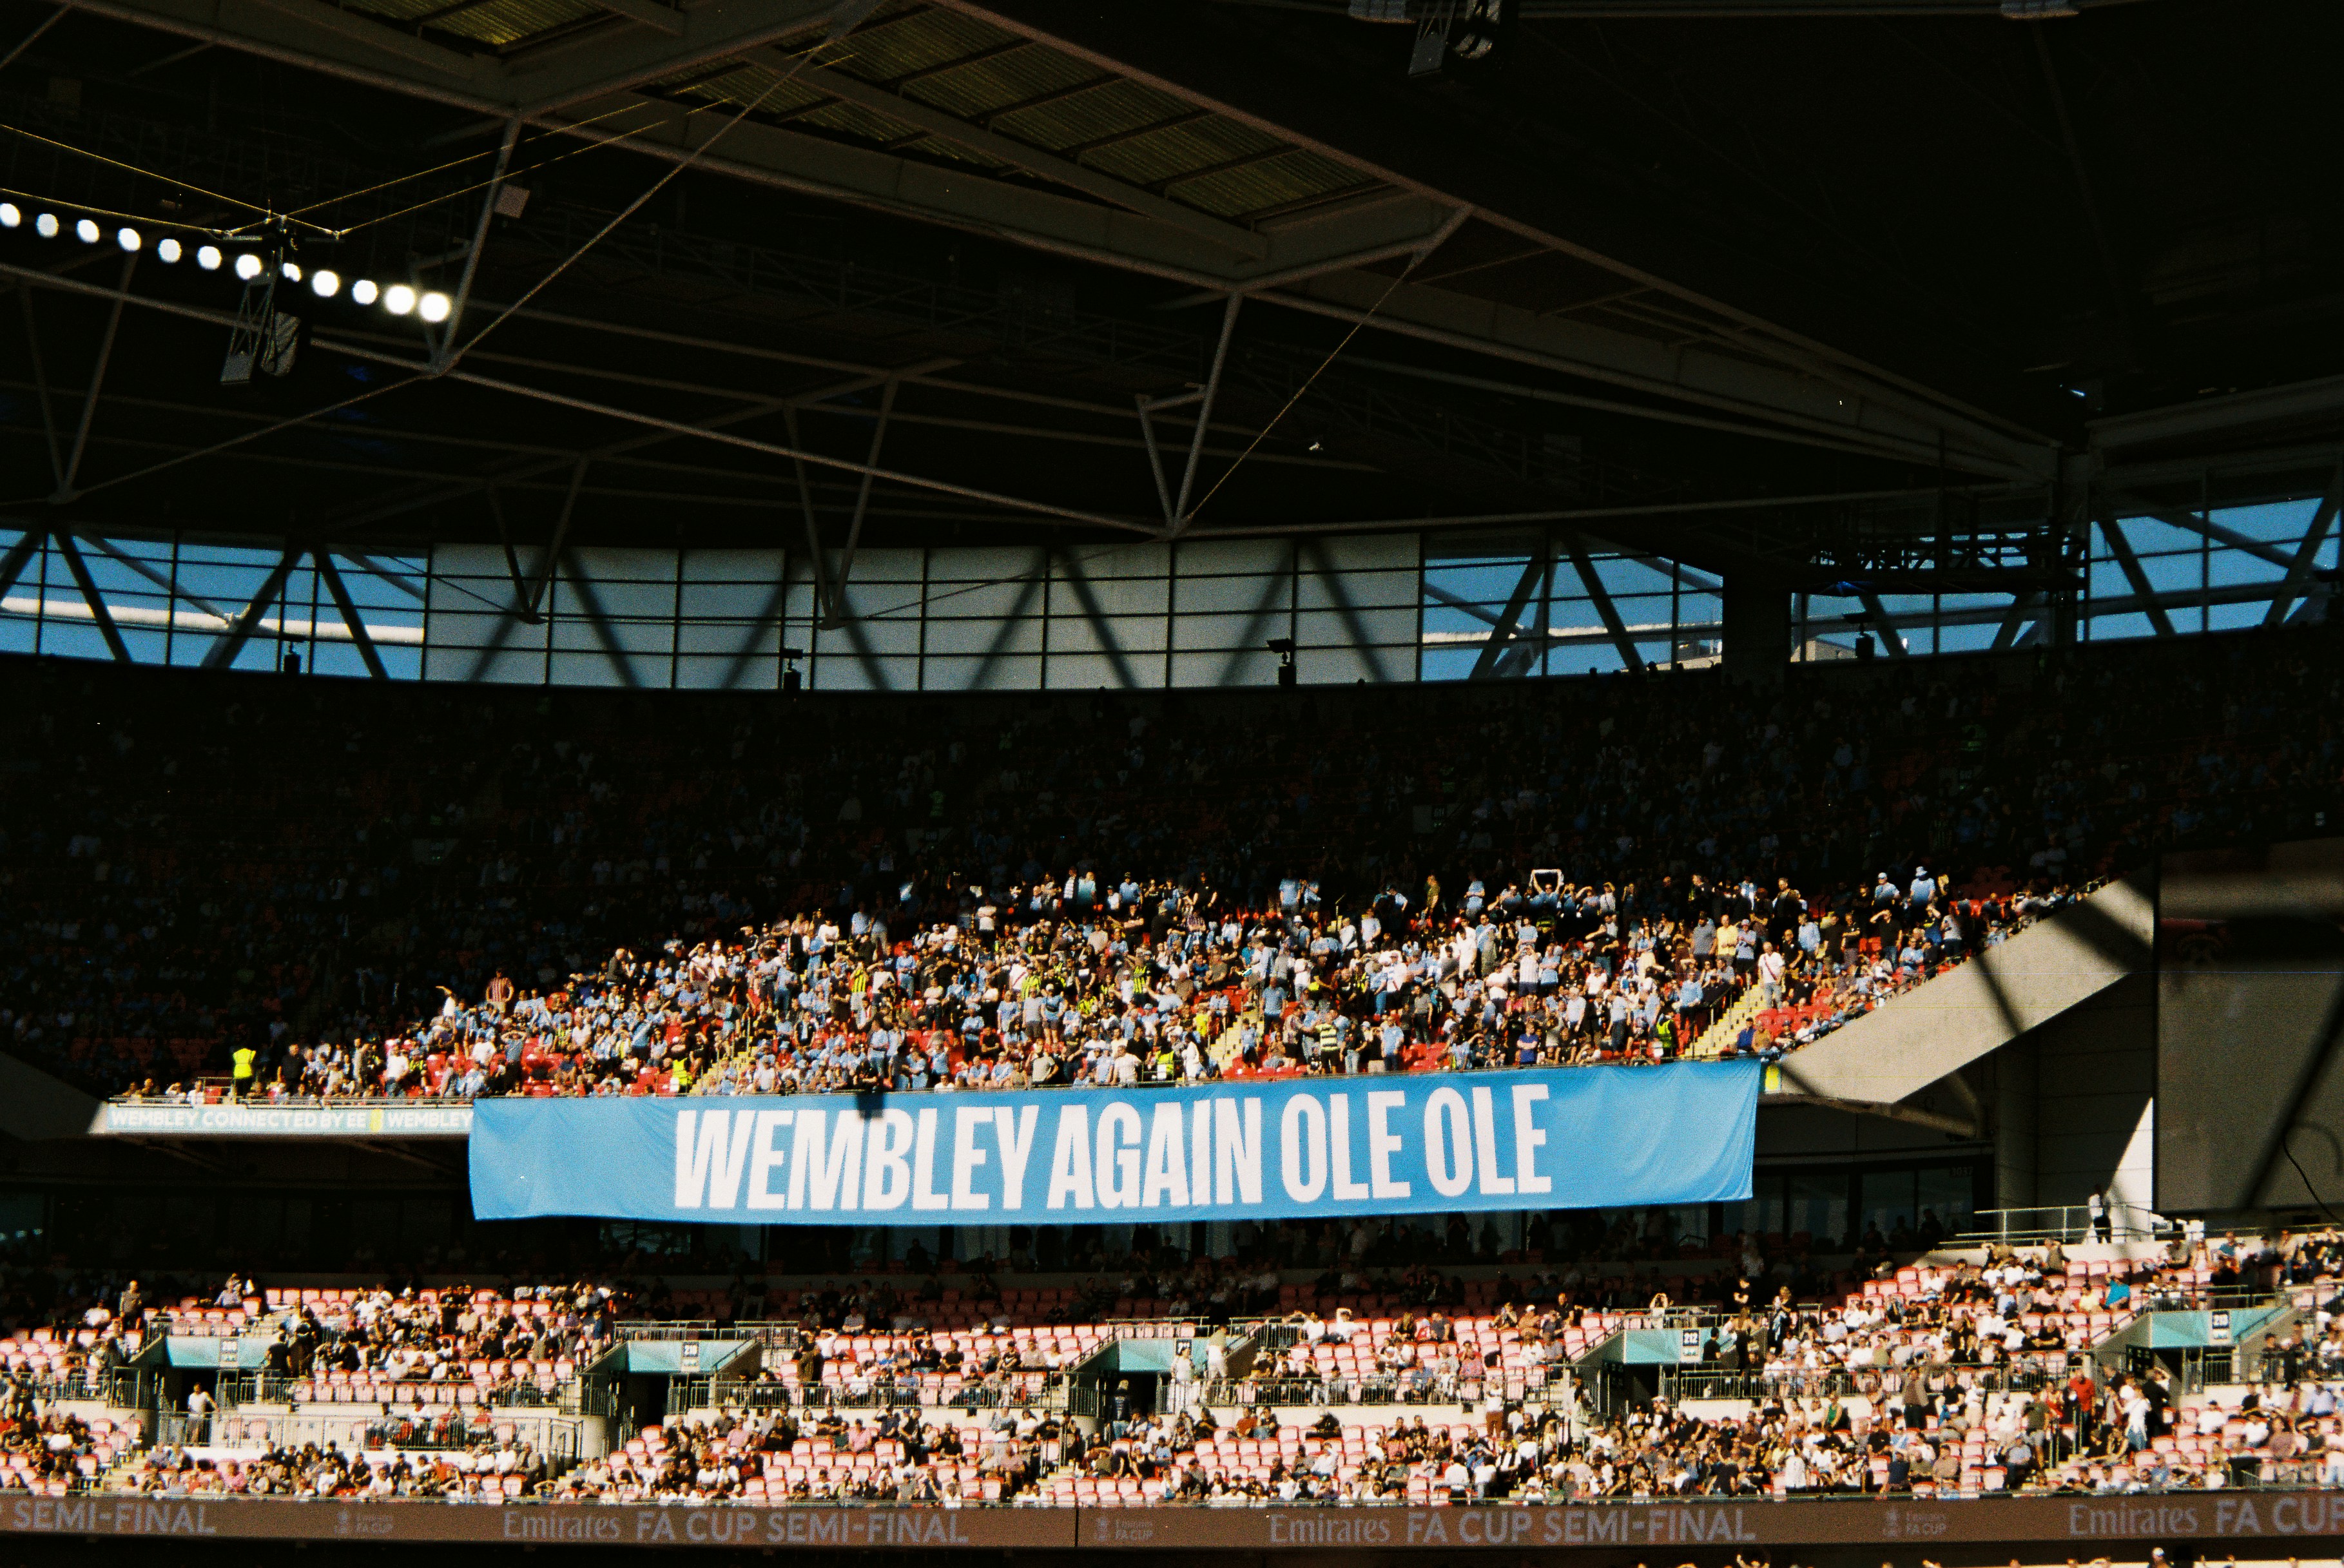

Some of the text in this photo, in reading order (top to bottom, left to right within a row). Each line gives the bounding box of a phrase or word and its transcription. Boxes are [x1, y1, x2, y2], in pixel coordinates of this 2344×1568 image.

[111, 1110, 367, 1128] WEMBLEY CONNECTED BY EE
[387, 1111, 474, 1127] WEMBLEY
[675, 1084, 1552, 1210] WEMBLEY AGAIN OLE OLE
[1683, 1332, 1698, 1344] 212
[12, 1500, 216, 1534] SEMI-FINAL
[503, 1510, 969, 1544] Emirates FA CUP SEMI-FINAL
[1270, 1509, 1756, 1543] Emirates FA CUP SEMI-FINAL
[2069, 1496, 2344, 1535] Emirates FA CUP
